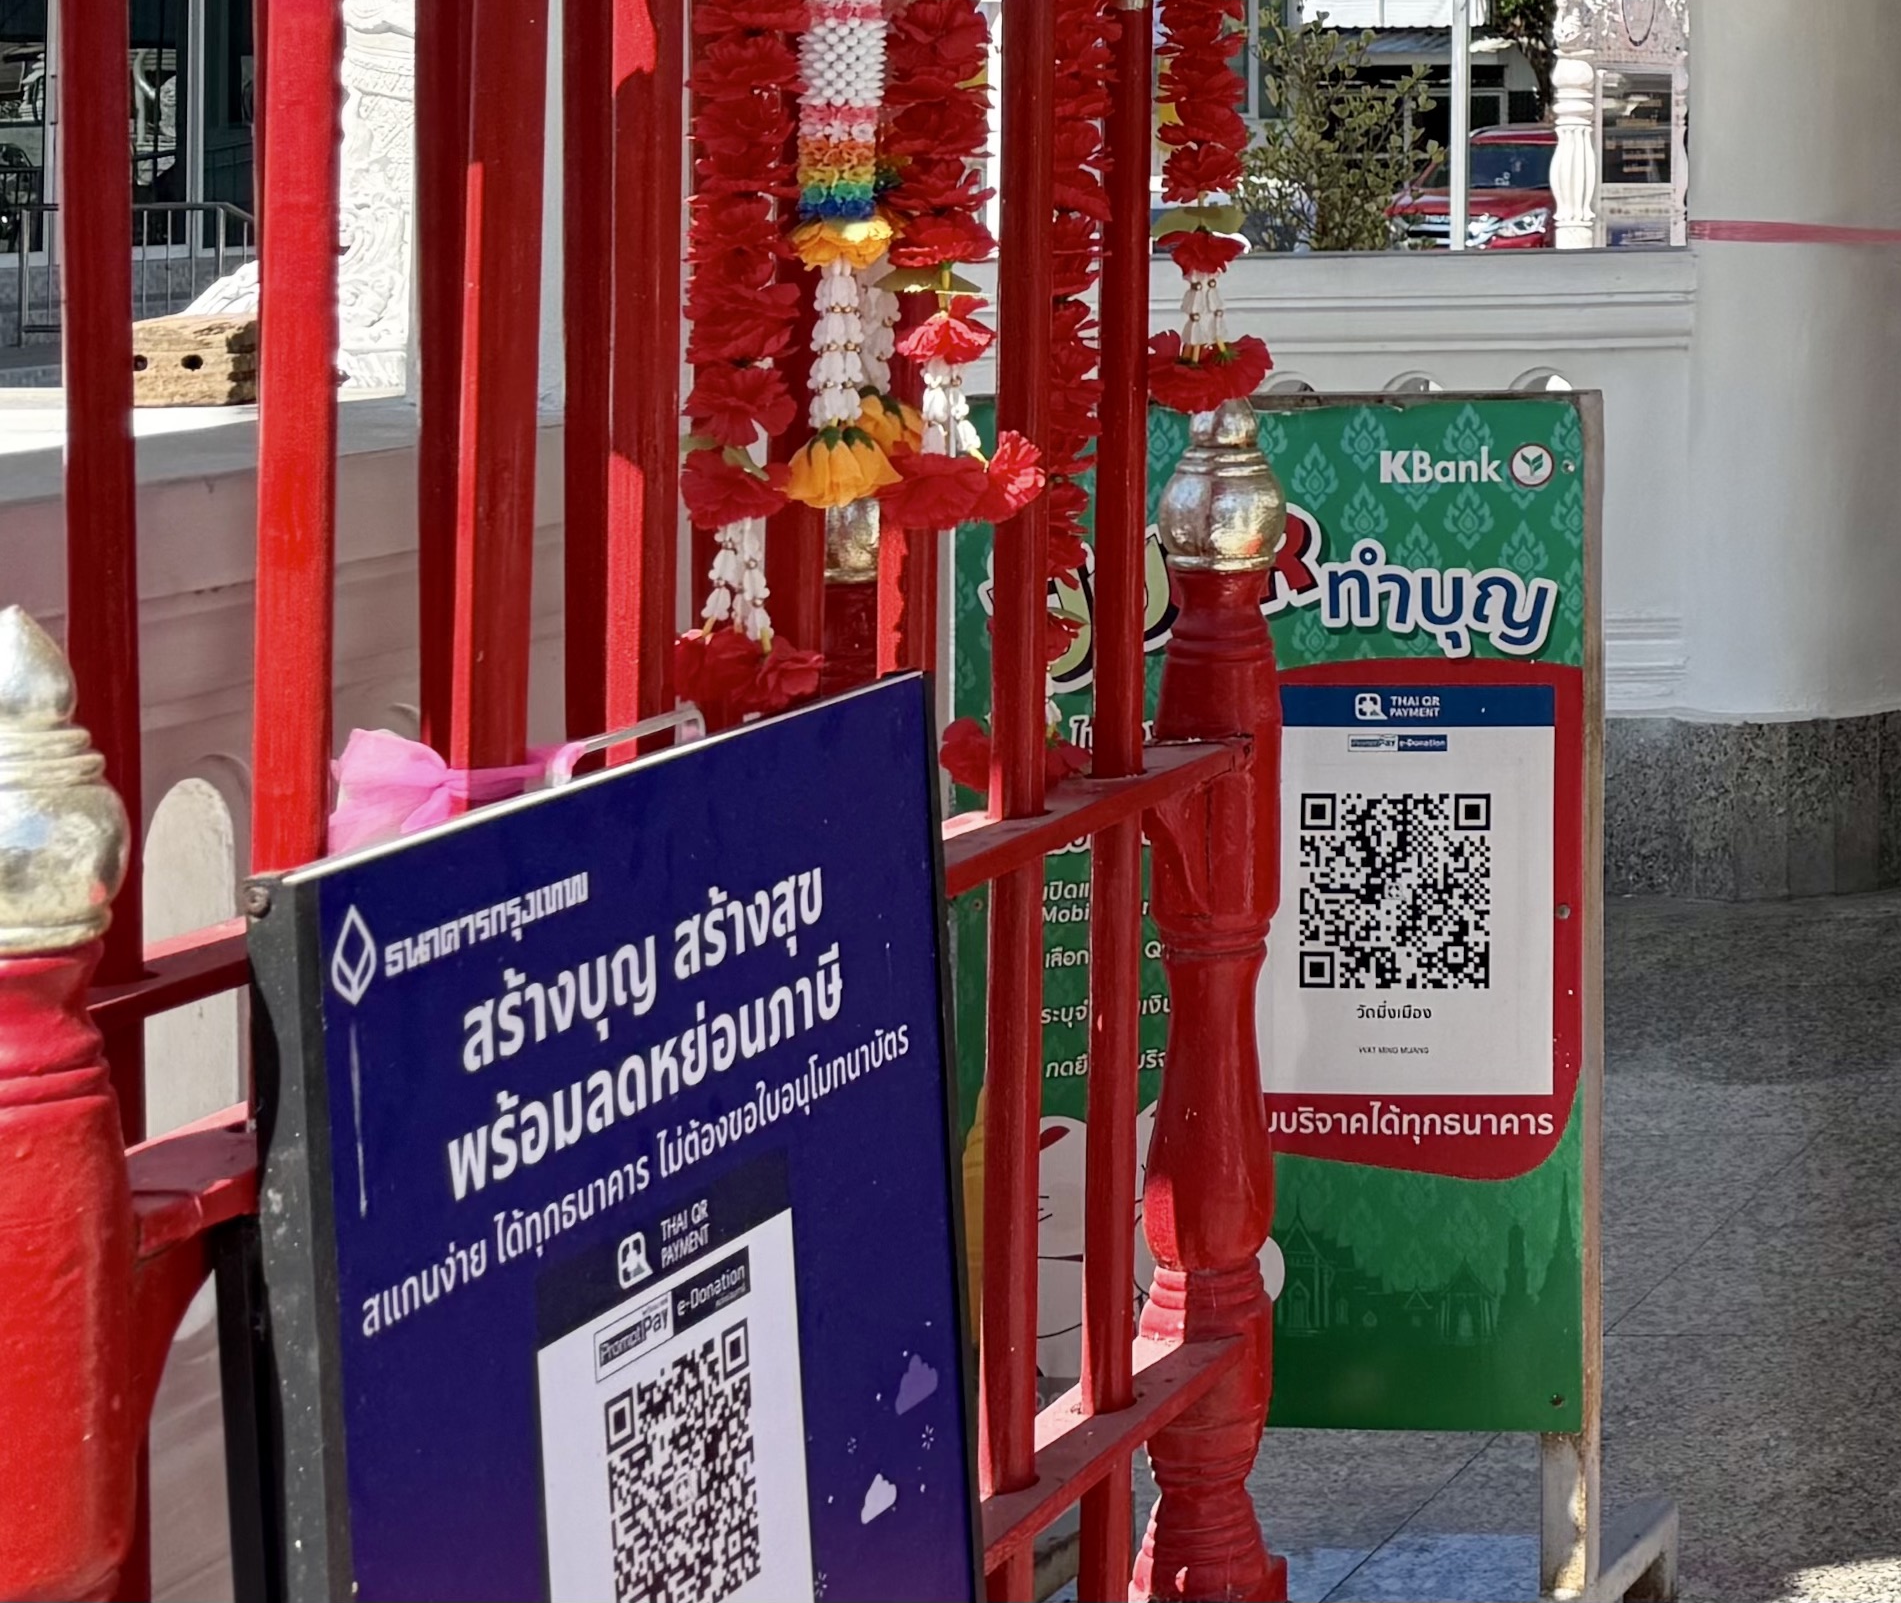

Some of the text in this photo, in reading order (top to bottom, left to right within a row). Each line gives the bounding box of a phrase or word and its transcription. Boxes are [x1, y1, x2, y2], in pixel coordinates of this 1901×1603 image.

[1379, 446, 1503, 484] KBank
[1325, 545, 1552, 652] ทำบุญ
[1390, 708, 1440, 718] PAYMENT
[385, 871, 589, 978] ธนาคารกรุงเทพ
[461, 864, 825, 1074] สร้างบุญ สร้างสุข
[1356, 1001, 1432, 1020] วัดมิ่งเมือง
[446, 942, 843, 1201] พร้อมลดหย่อนภาษี
[362, 1023, 910, 1338] สแกนง่าย ได้ทุกธนาคาร ไม่ต้องขอใบอนุโมทนาบัตร
[660, 1198, 709, 1242] THAI QR
[660, 1222, 710, 1269] PAYMENT
[676, 1264, 746, 1317] e-Donation
